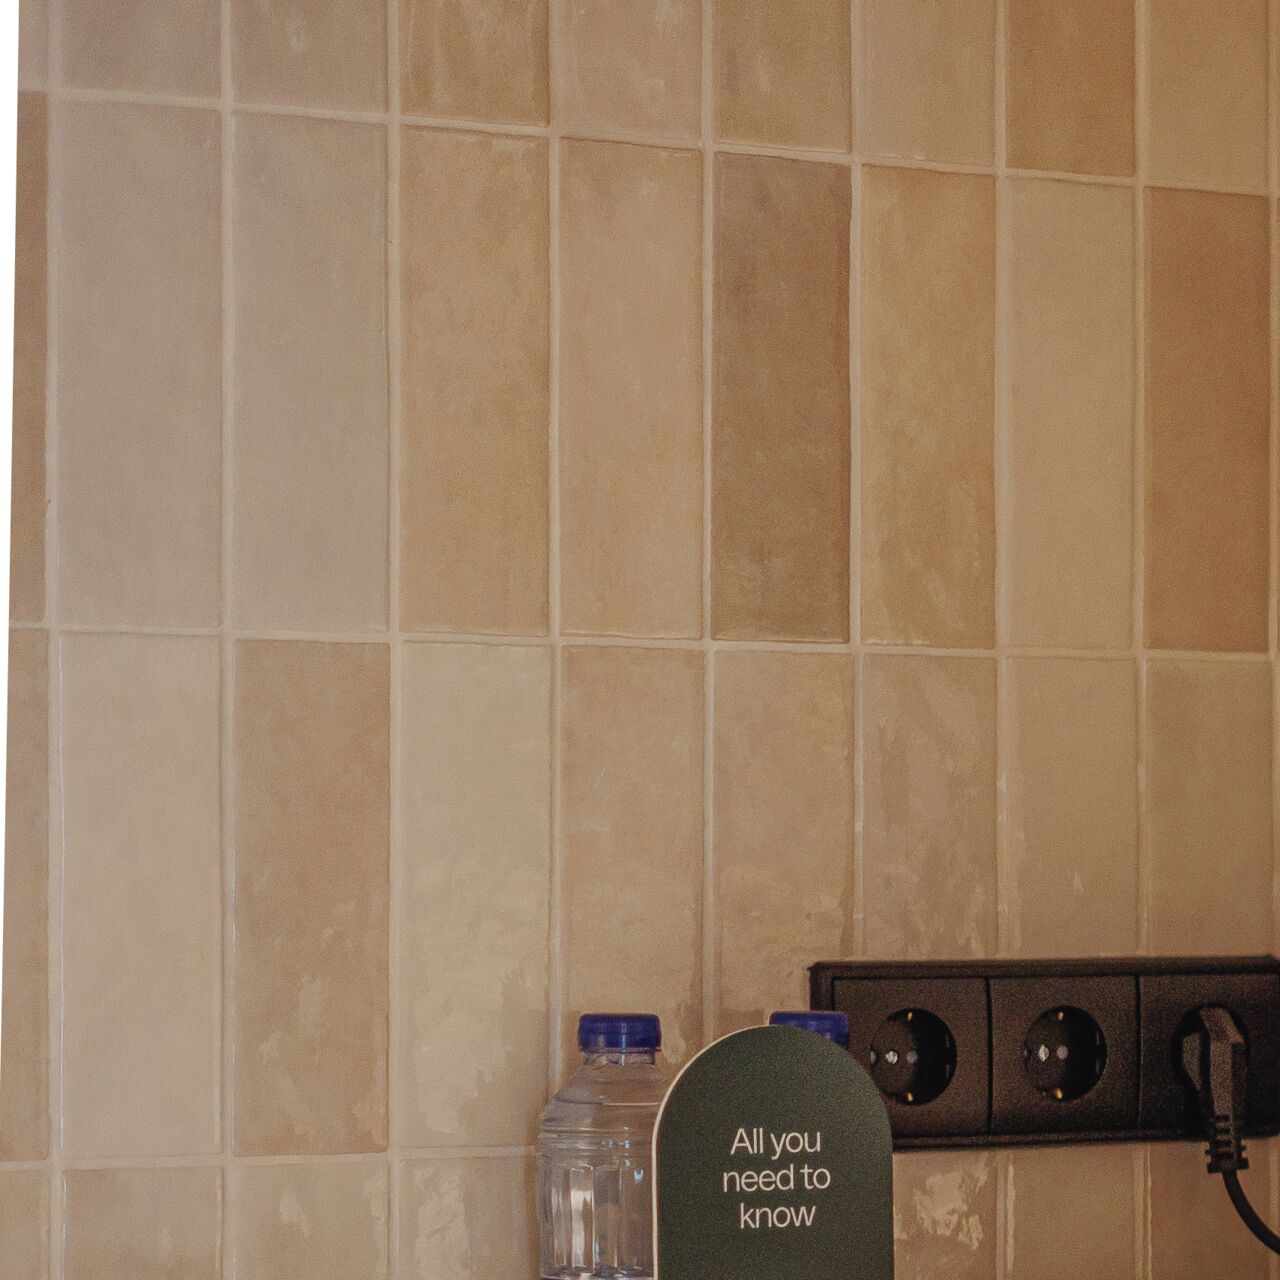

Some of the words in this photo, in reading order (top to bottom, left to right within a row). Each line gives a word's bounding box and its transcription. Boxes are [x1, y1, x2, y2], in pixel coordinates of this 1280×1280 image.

[730, 1127, 764, 1155] All
[770, 1131, 821, 1160] you
[723, 1163, 794, 1193] need
[799, 1163, 831, 1190] to
[740, 1202, 816, 1229] know
